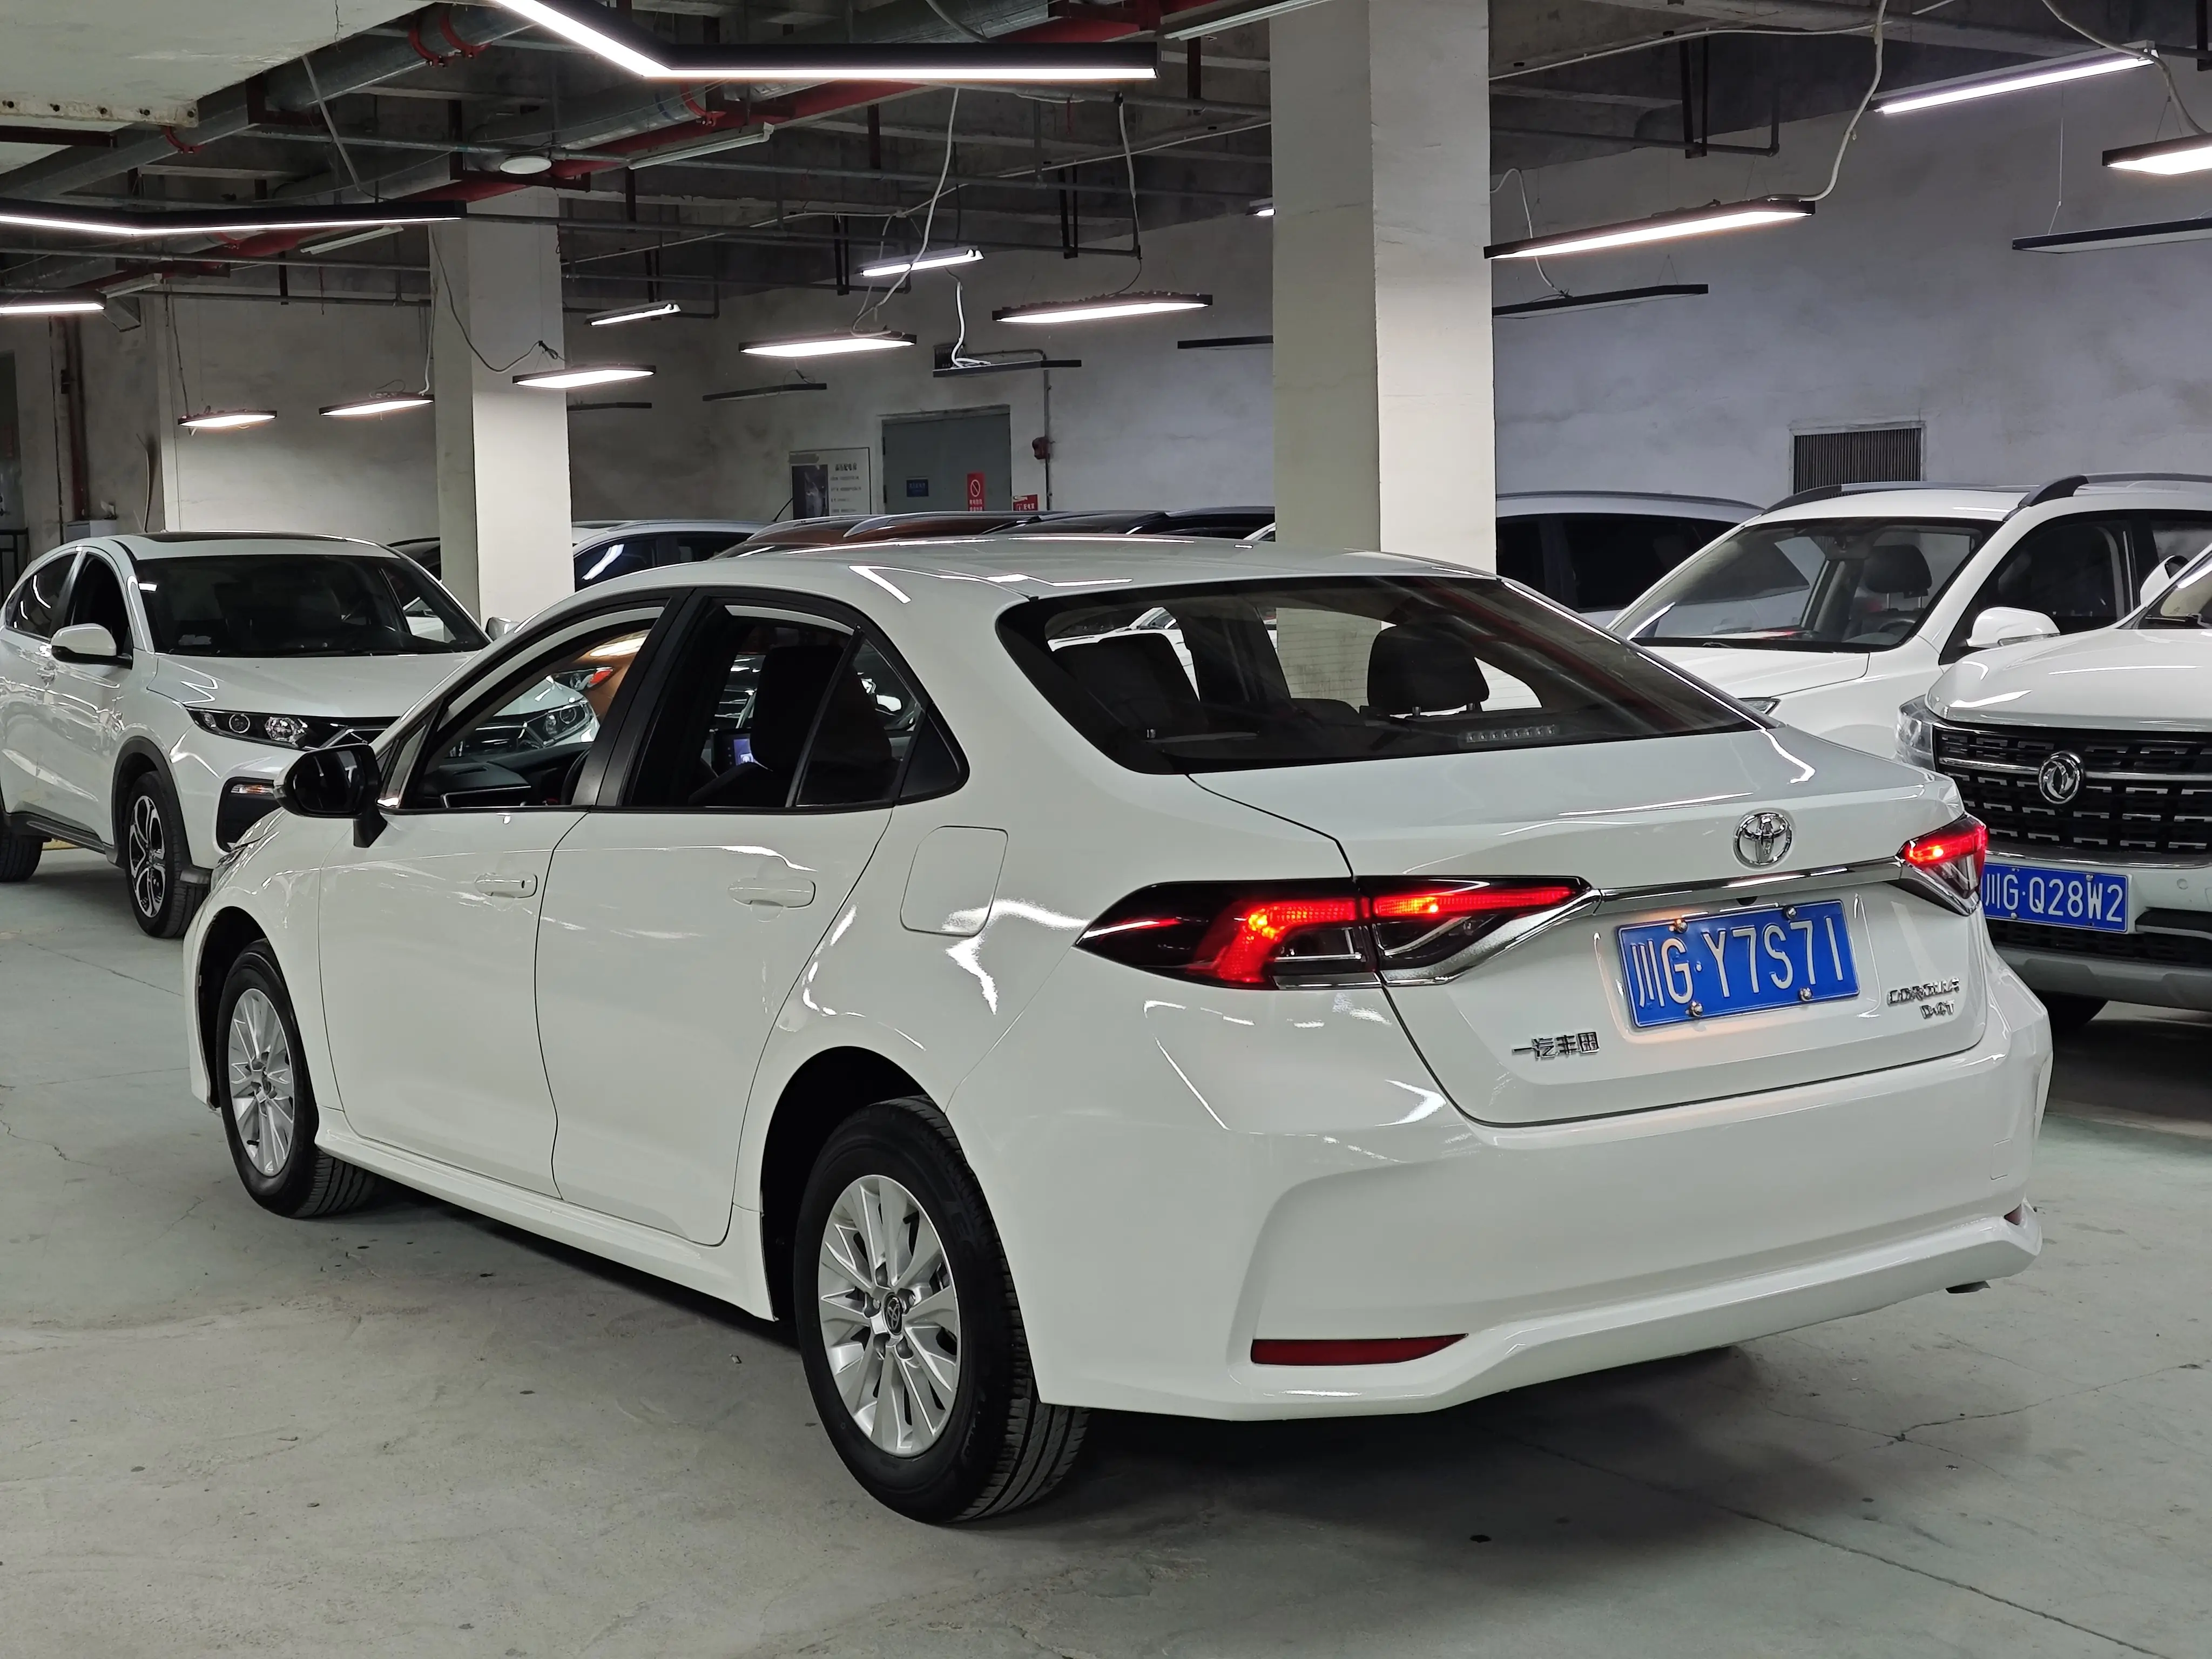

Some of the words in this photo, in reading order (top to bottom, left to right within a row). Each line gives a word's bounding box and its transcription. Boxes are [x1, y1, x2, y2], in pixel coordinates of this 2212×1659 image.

[1985, 873, 2123, 922] 川G·Q28W2
[1630, 916, 1844, 1008] 川G·Y7S71
[1512, 1031, 1600, 1061] 一汽丰田
